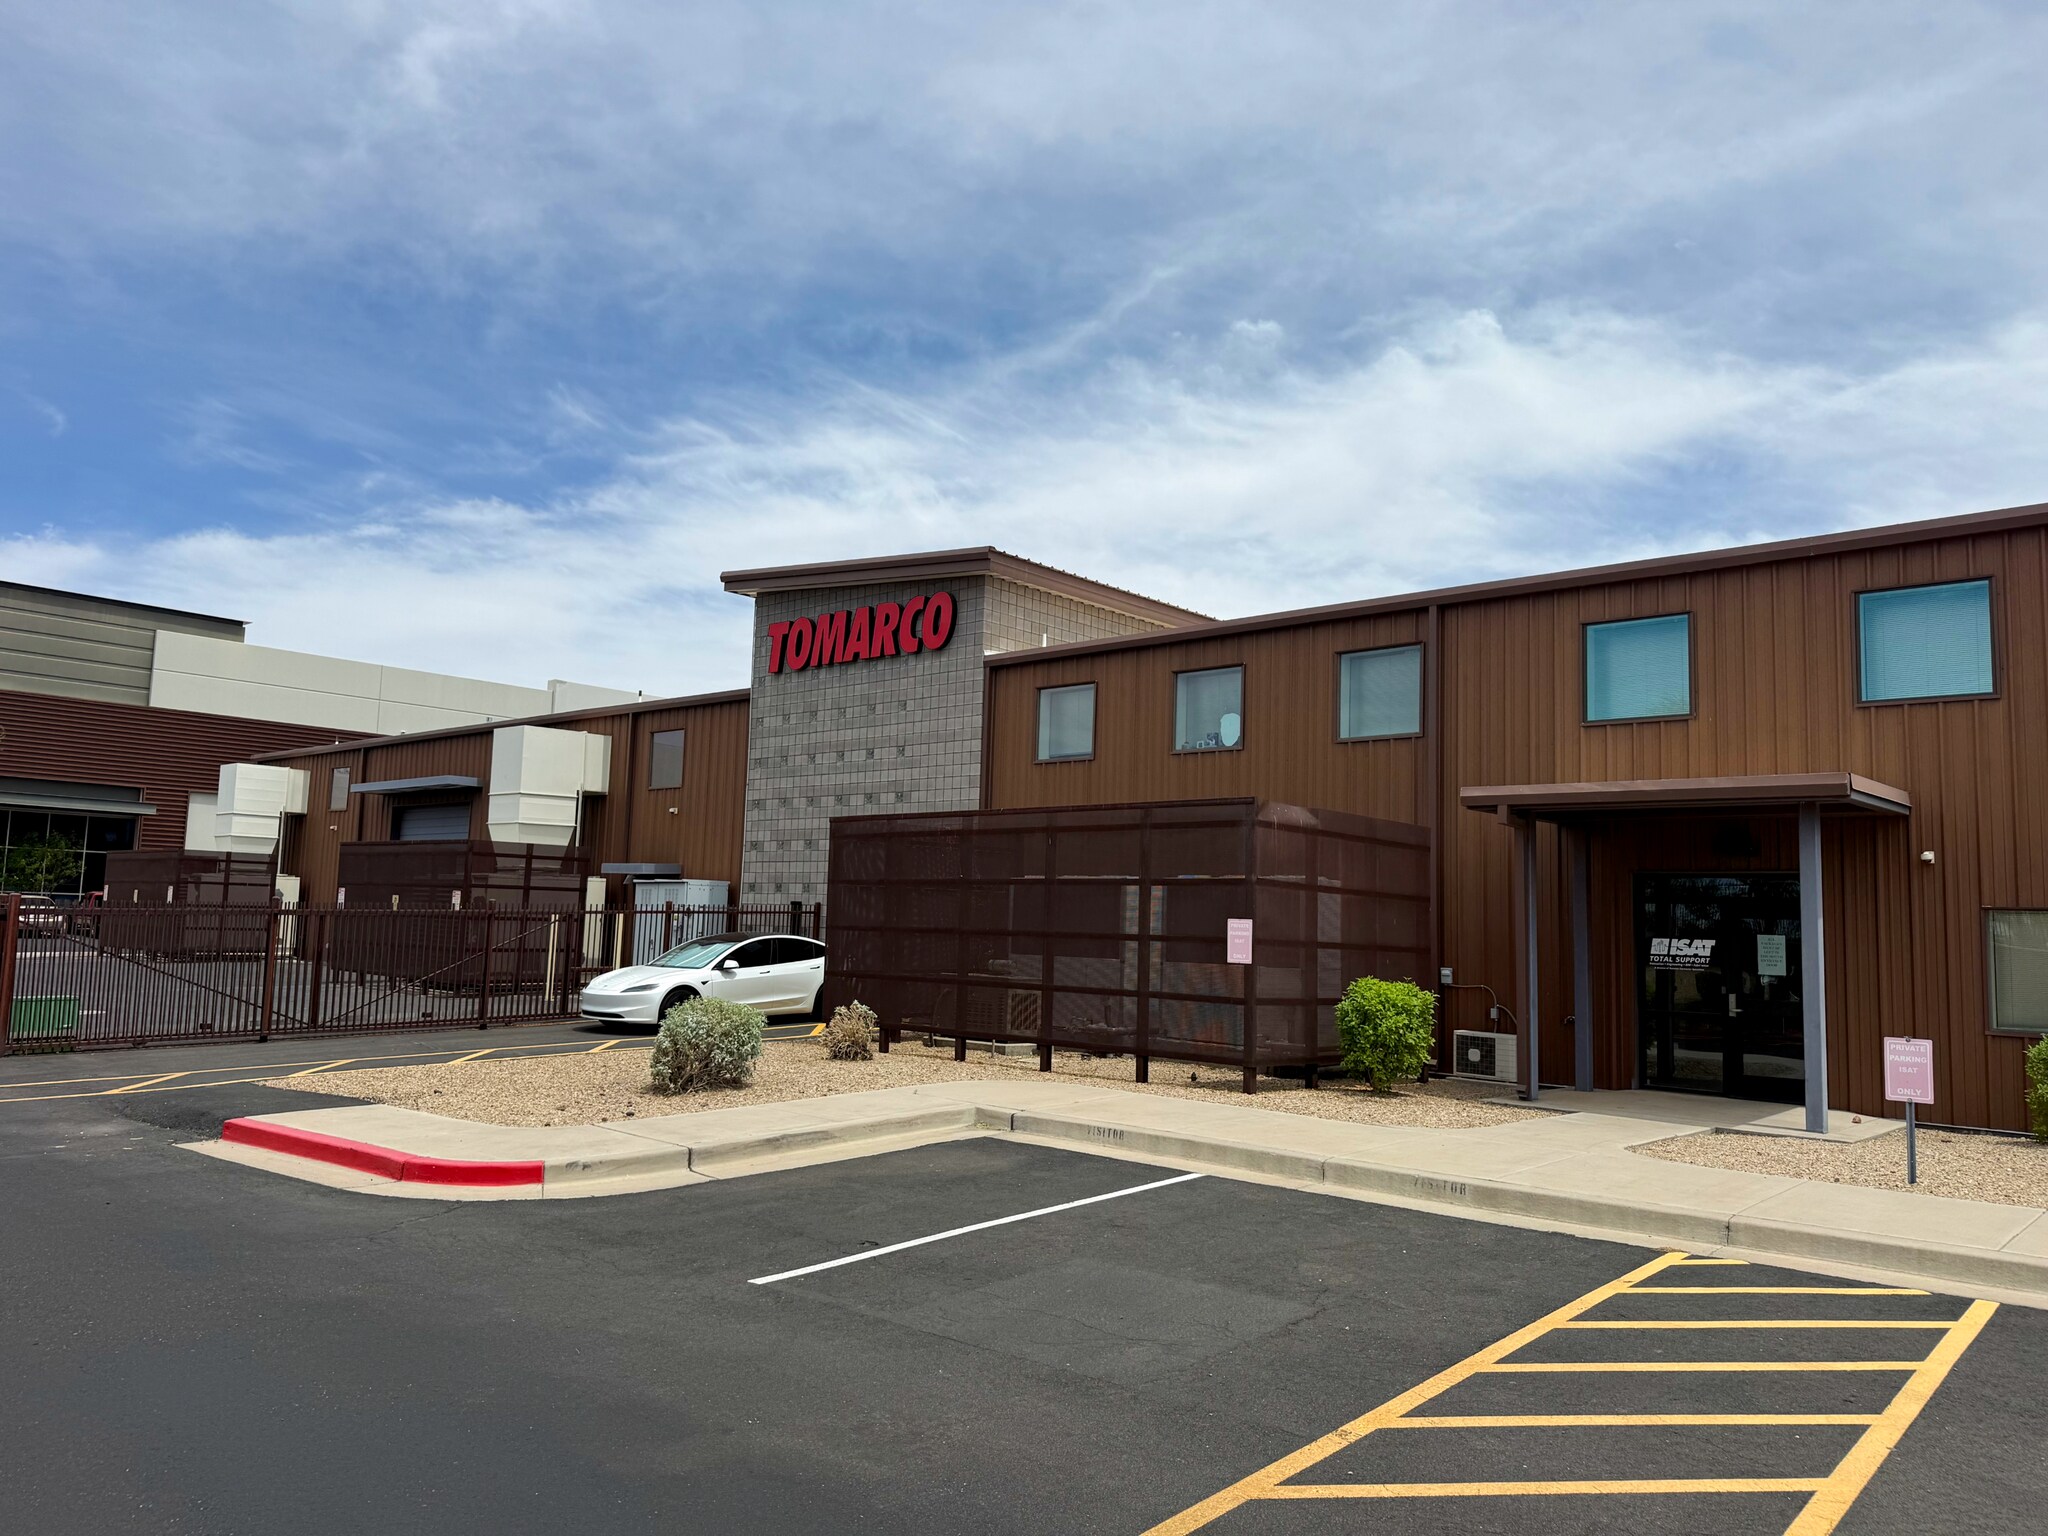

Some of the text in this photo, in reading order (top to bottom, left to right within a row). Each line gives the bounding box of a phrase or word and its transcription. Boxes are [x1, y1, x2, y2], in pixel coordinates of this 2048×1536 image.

[767, 591, 956, 674] TOMARCO
[1669, 938, 1716, 956] ISAT
[1650, 955, 1710, 964] TOTAL SUPPORT
[1890, 1044, 1926, 1052] PRIVATE
[1889, 1055, 1927, 1063] PARKING
[1897, 1087, 1922, 1096] ONLY
[1087, 1125, 1125, 1140] VISITOR
